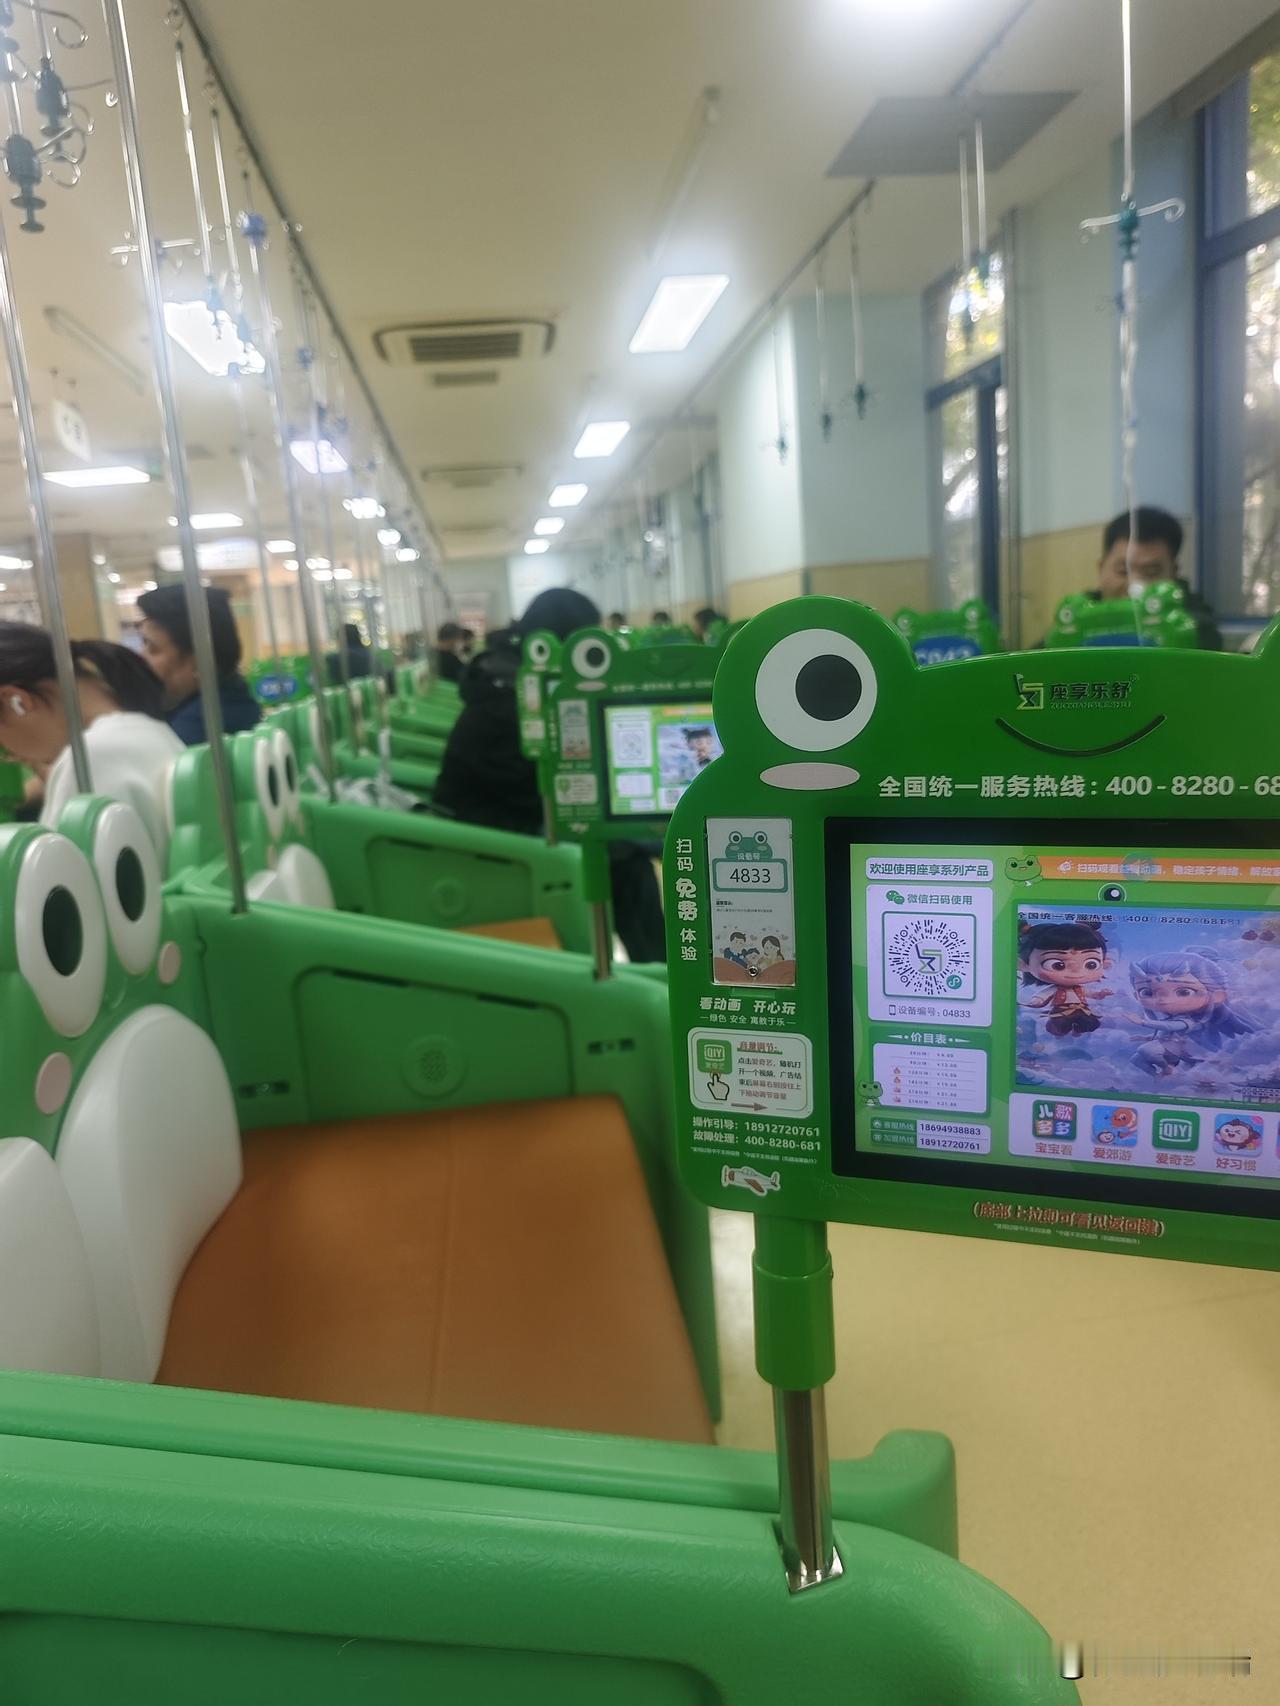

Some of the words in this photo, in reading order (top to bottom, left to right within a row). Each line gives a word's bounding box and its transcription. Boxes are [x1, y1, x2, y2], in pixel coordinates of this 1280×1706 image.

[1050, 681, 1132, 701] 座享乐舒
[729, 868, 772, 884] 4833
[869, 863, 990, 877] 欢迎使用座享系列产品
[907, 893, 973, 905] 微信扫码使用
[700, 997, 742, 1012] 看动画
[753, 1000, 797, 1015] 开心玩
[910, 1032, 947, 1045] 价目表
[919, 1123, 982, 1136] 18694938883
[919, 1137, 981, 1150] 18912720761
[1155, 1153, 1196, 1166] 爱奇艺
[1215, 1157, 1257, 1172] 好习惯
